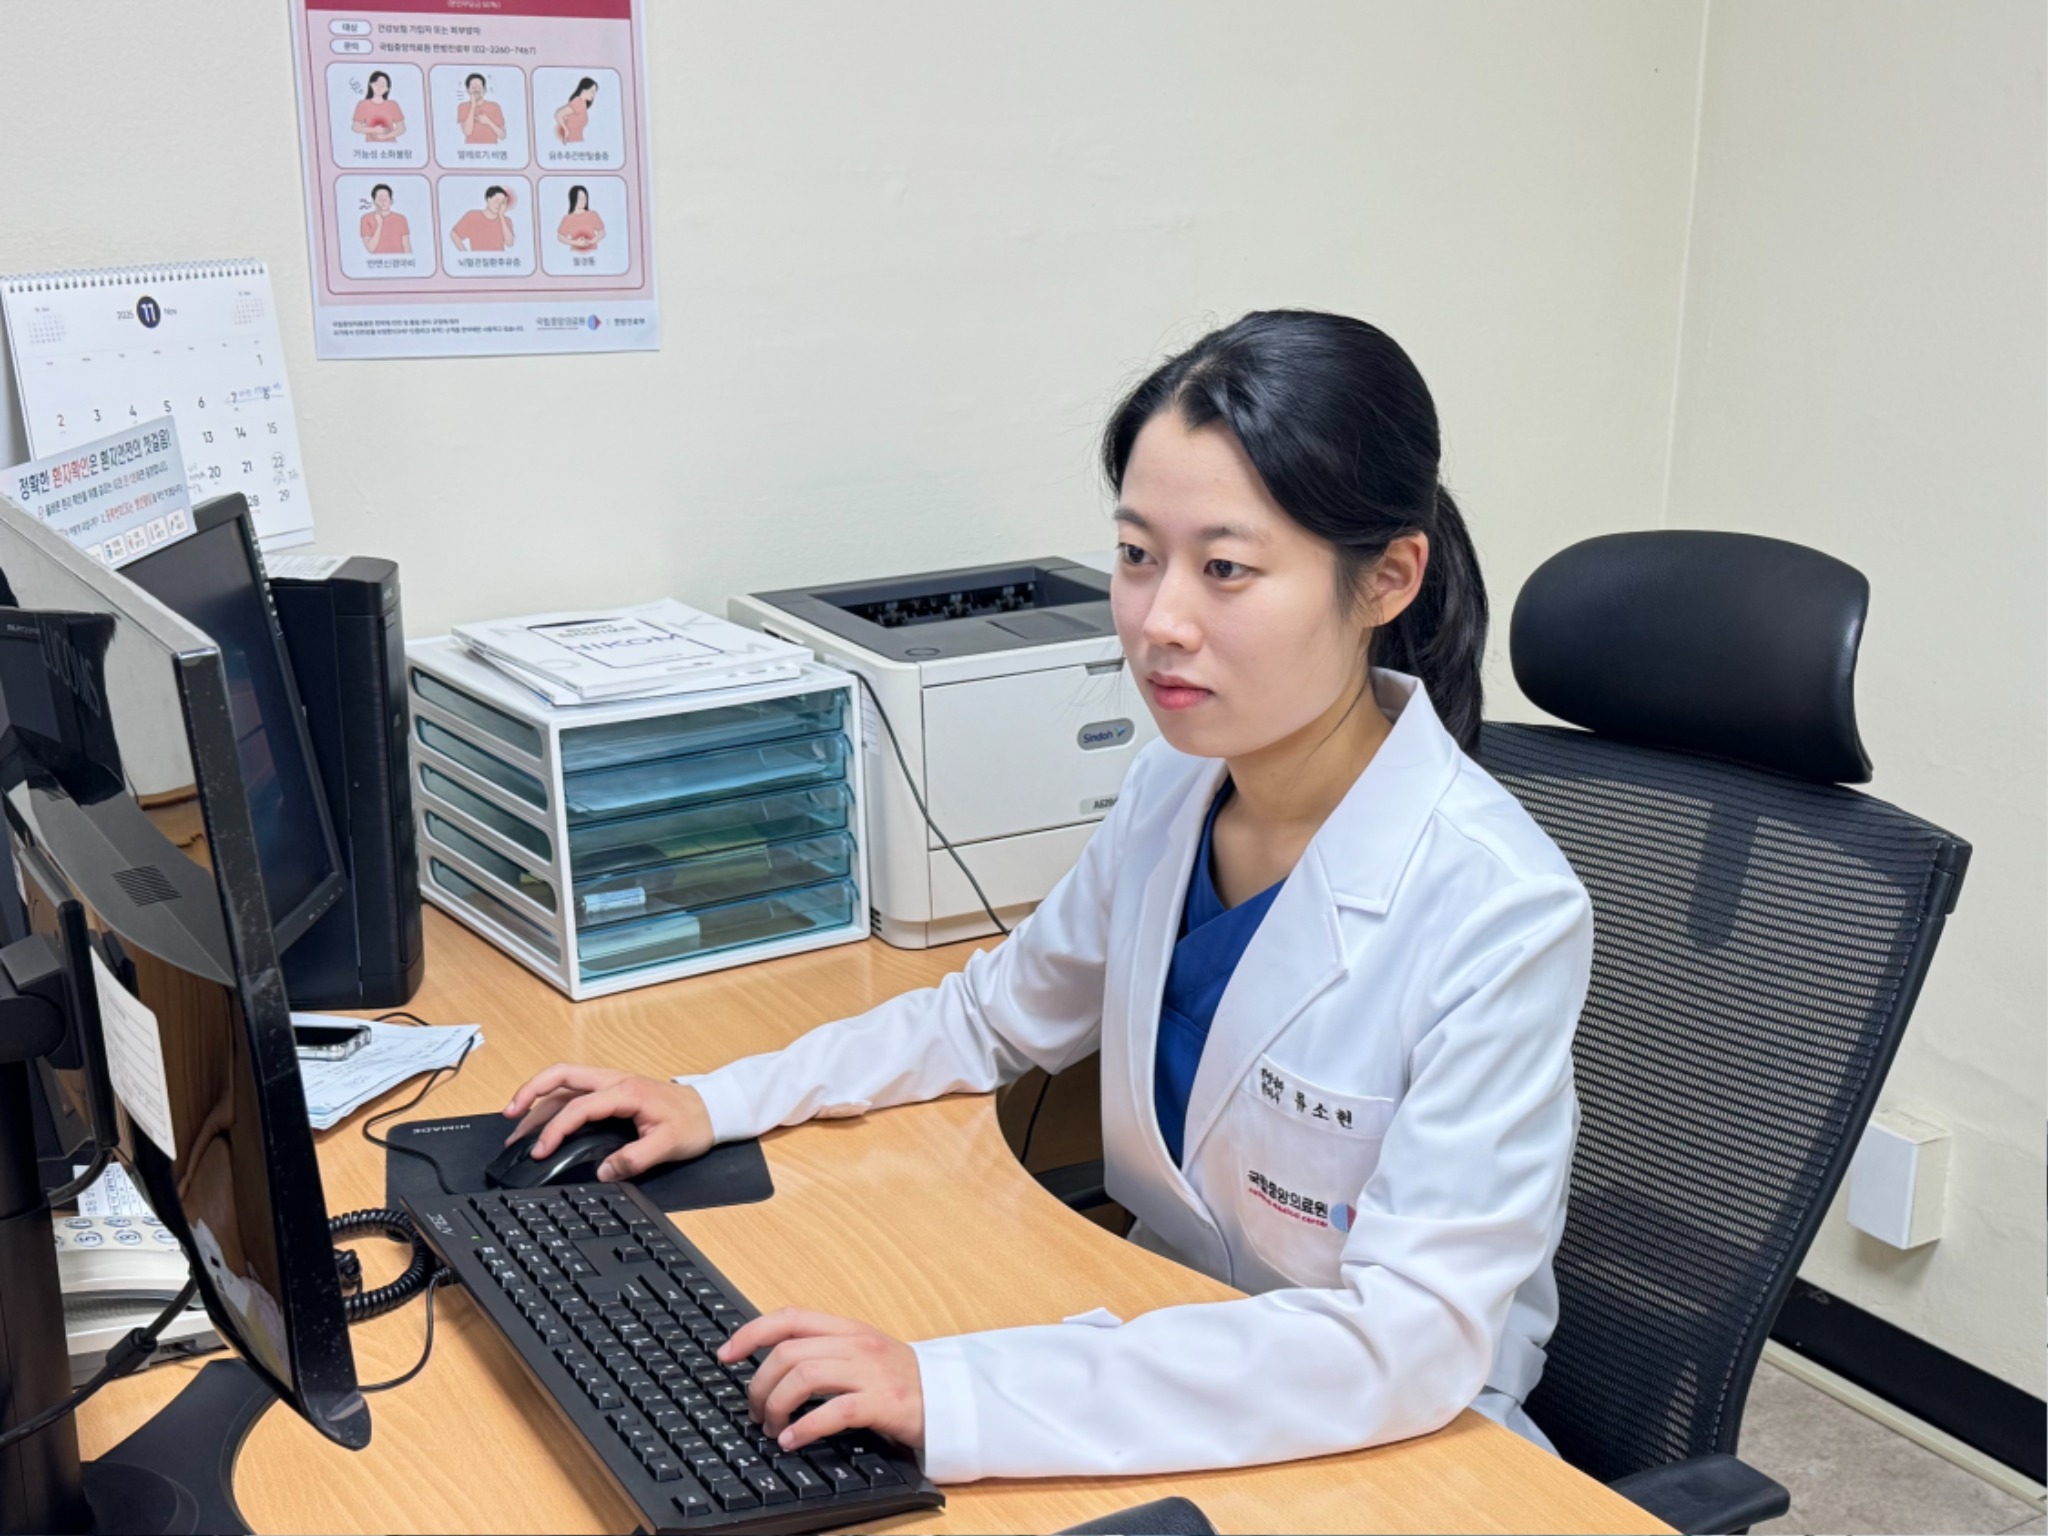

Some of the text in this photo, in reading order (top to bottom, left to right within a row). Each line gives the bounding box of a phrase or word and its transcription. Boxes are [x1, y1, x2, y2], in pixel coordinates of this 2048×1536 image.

[257, 354, 264, 366] 1
[57, 414, 65, 427] 2
[94, 409, 102, 422] 3
[129, 404, 137, 416] 4
[163, 400, 172, 413] 5
[197, 396, 206, 409] 6
[202, 422, 278, 443] 13 14 15
[208, 466, 221, 479] 20
[242, 461, 254, 474] 21
[272, 456, 285, 469] 22
[248, 489, 290, 507] 28 29
[1083, 730, 1113, 744] Sindoh
[1248, 1170, 1328, 1220] 국립중앙의료원
